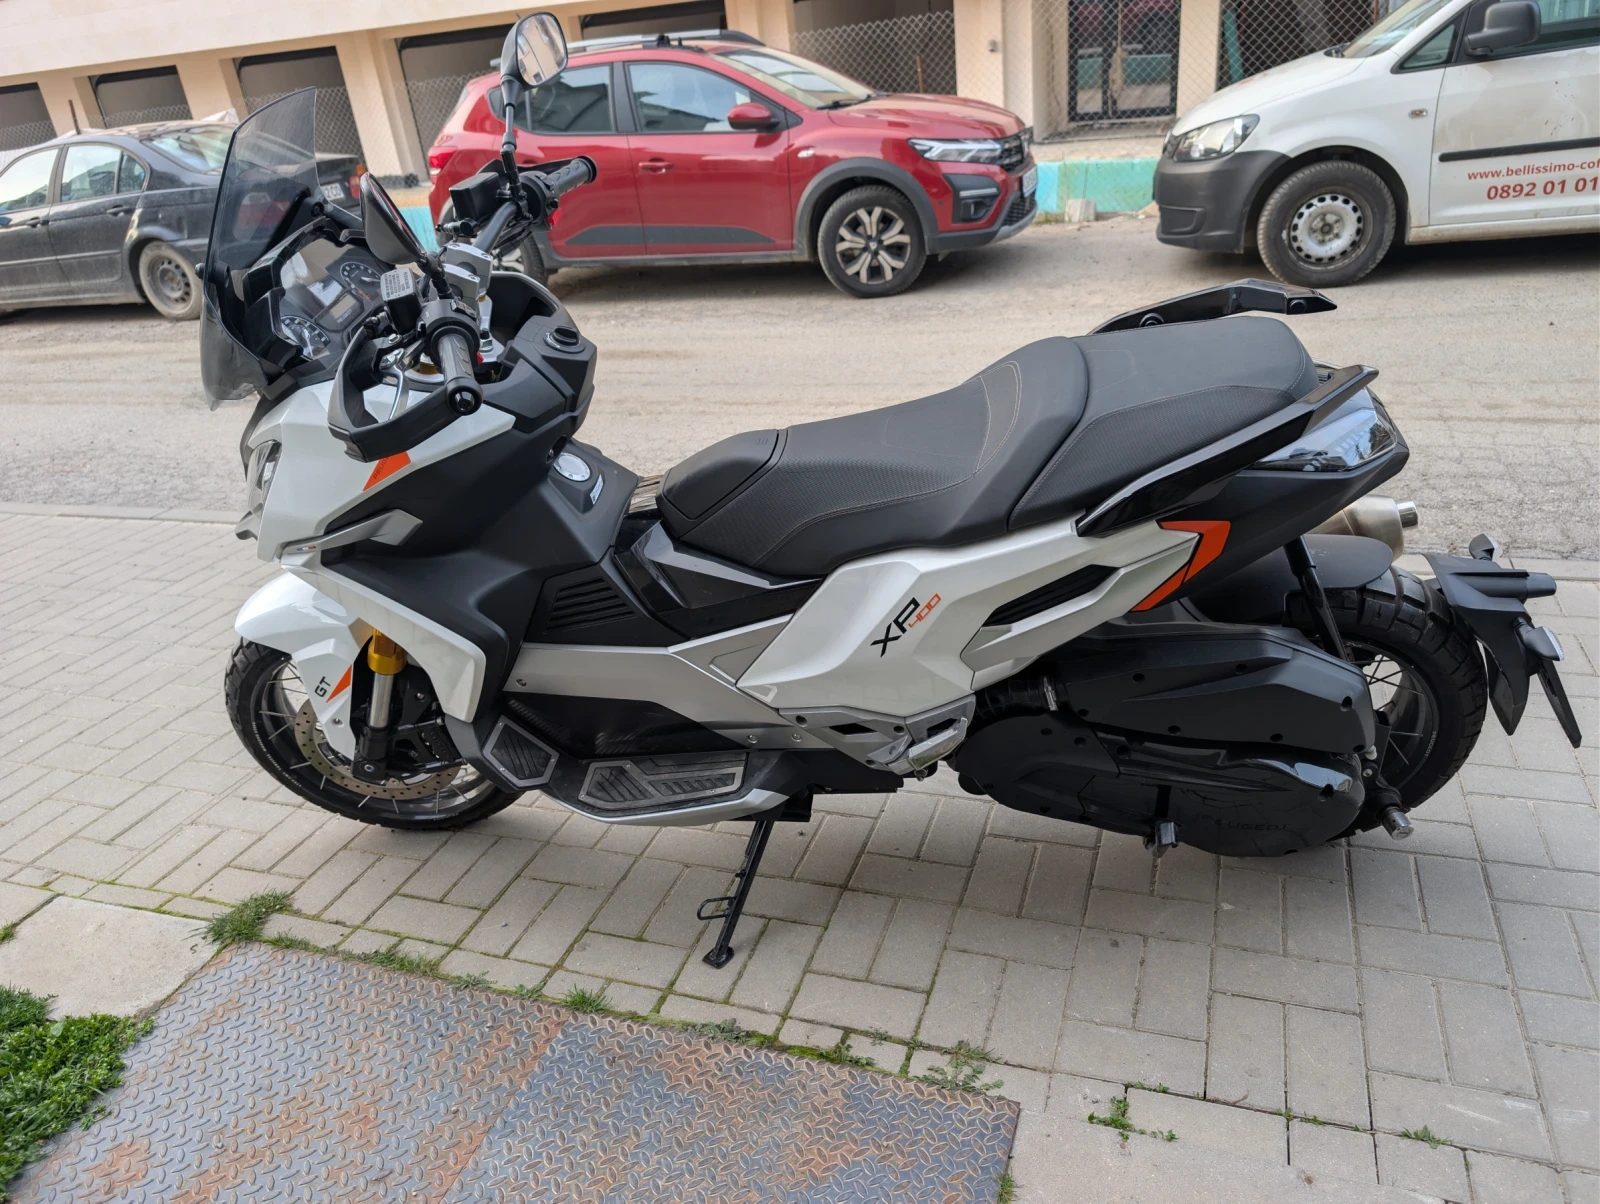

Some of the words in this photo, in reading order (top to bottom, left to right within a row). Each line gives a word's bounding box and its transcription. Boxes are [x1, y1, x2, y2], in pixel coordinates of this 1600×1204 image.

[1486, 182, 1537, 200] 0892
[1542, 179, 1567, 196] 01
[1574, 176, 1600, 193] 01
[314, 675, 331, 698] GT
